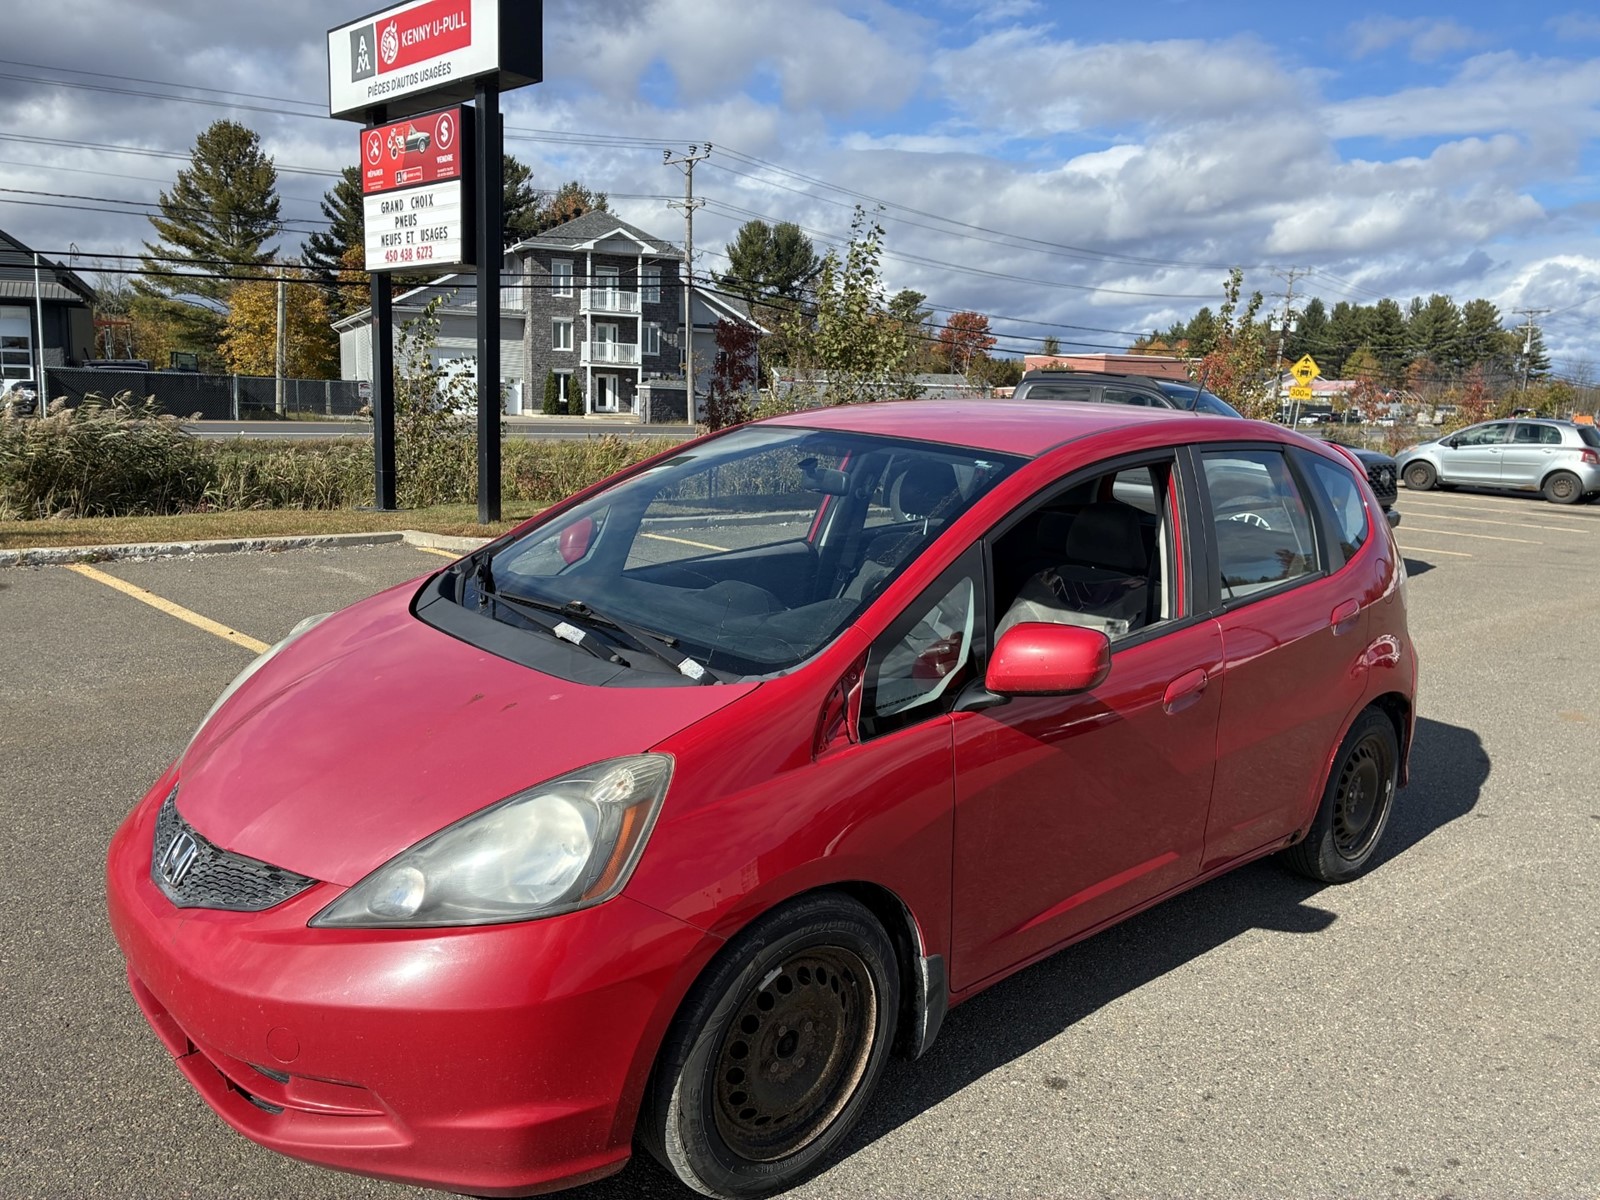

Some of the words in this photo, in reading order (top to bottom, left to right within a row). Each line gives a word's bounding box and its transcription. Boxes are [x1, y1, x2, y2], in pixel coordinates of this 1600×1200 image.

[401, 22, 432, 47] KENNY
[433, 11, 467, 36] U-PULL
[367, 80, 390, 98] PIÈCES
[391, 74, 418, 91] D'AUTOS
[419, 61, 452, 83] USAGÉES
[381, 199, 404, 214] GRAND
[410, 193, 434, 209] CHOIX
[395, 213, 417, 229] PNEUS
[381, 232, 402, 247] NEUFS
[406, 231, 414, 244] ET
[420, 226, 448, 242] USAGES
[385, 249, 398, 262] 450
[400, 247, 413, 261] 438
[416, 245, 433, 260] 6273
[1291, 389, 1304, 397] 300
